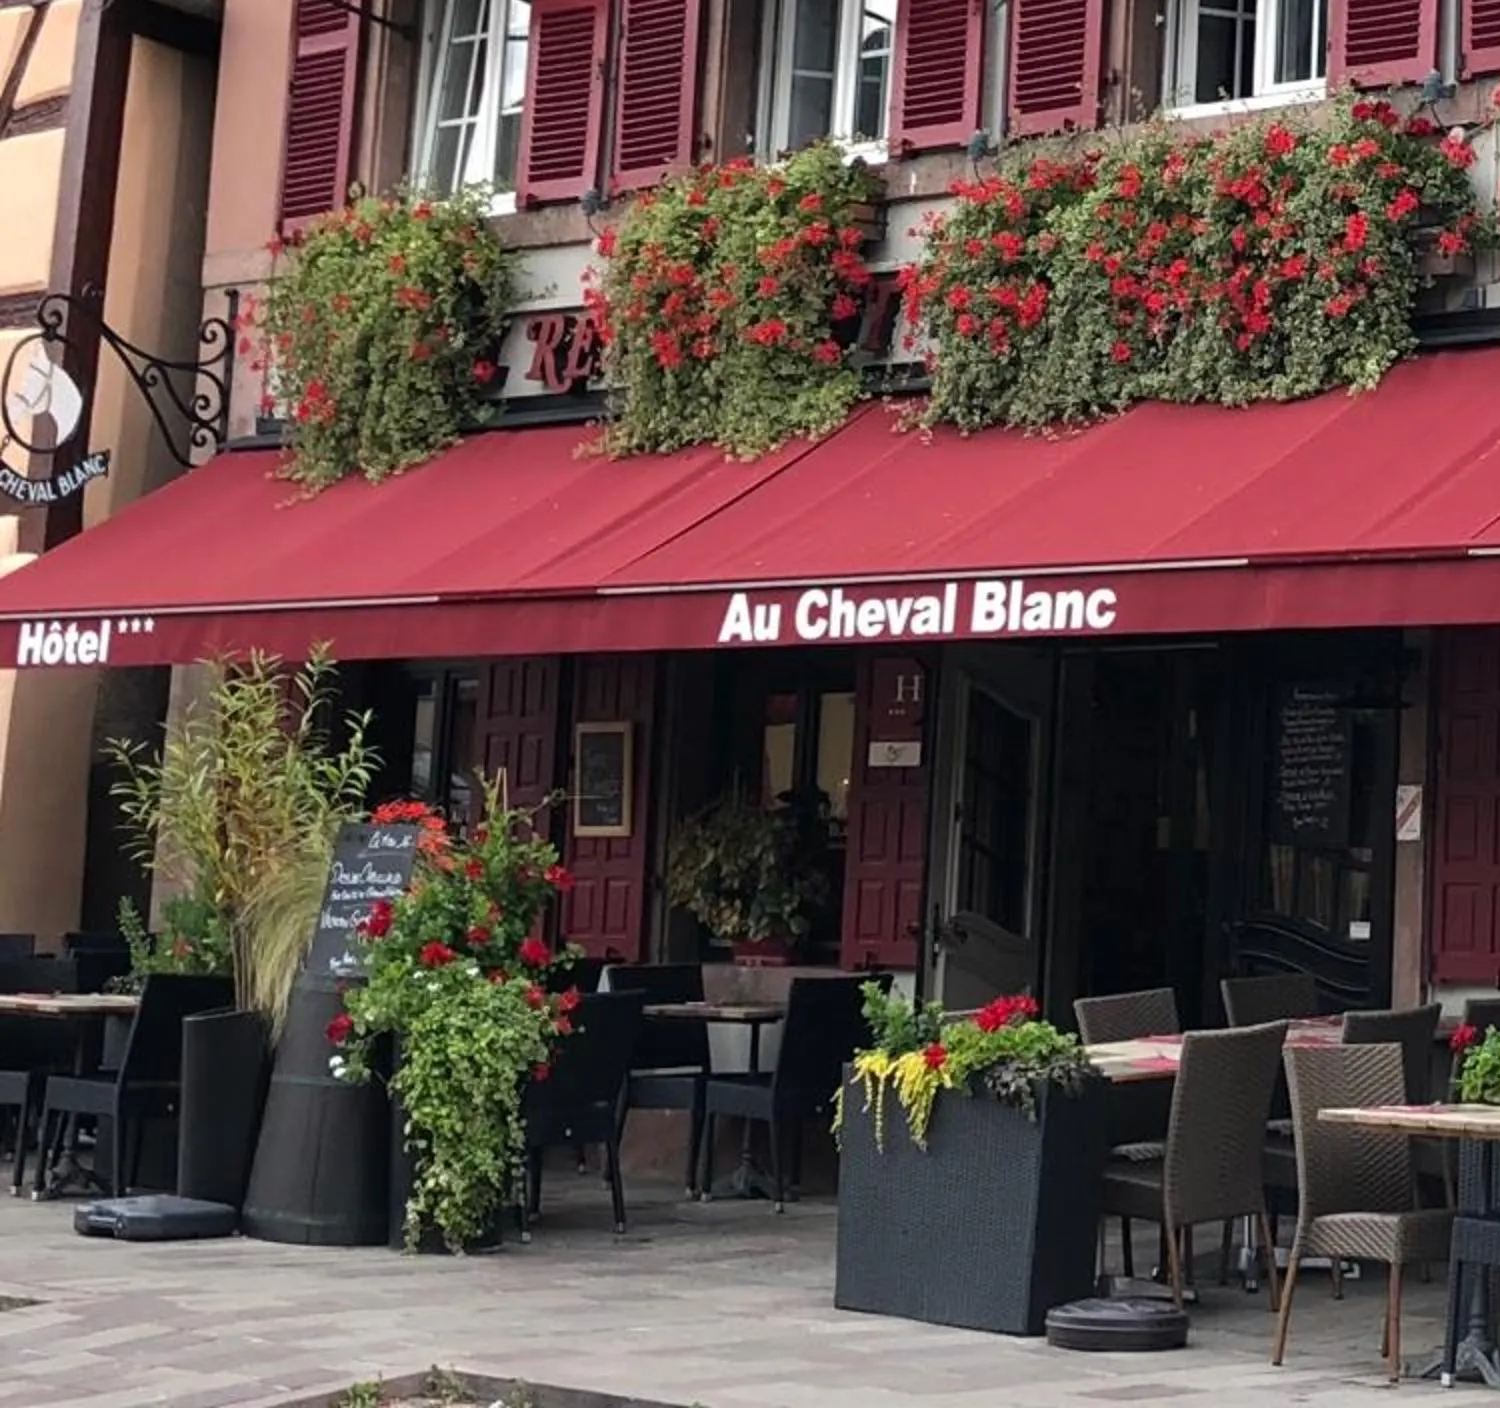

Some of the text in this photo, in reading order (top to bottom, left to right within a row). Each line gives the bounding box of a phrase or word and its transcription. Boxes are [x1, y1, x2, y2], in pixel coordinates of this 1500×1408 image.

[0, 455, 107, 502] CHEVAL BLANC
[718, 580, 1117, 642] Au Cheval Blanc
[17, 620, 111, 665] Hôtel
[895, 675, 922, 702] H
